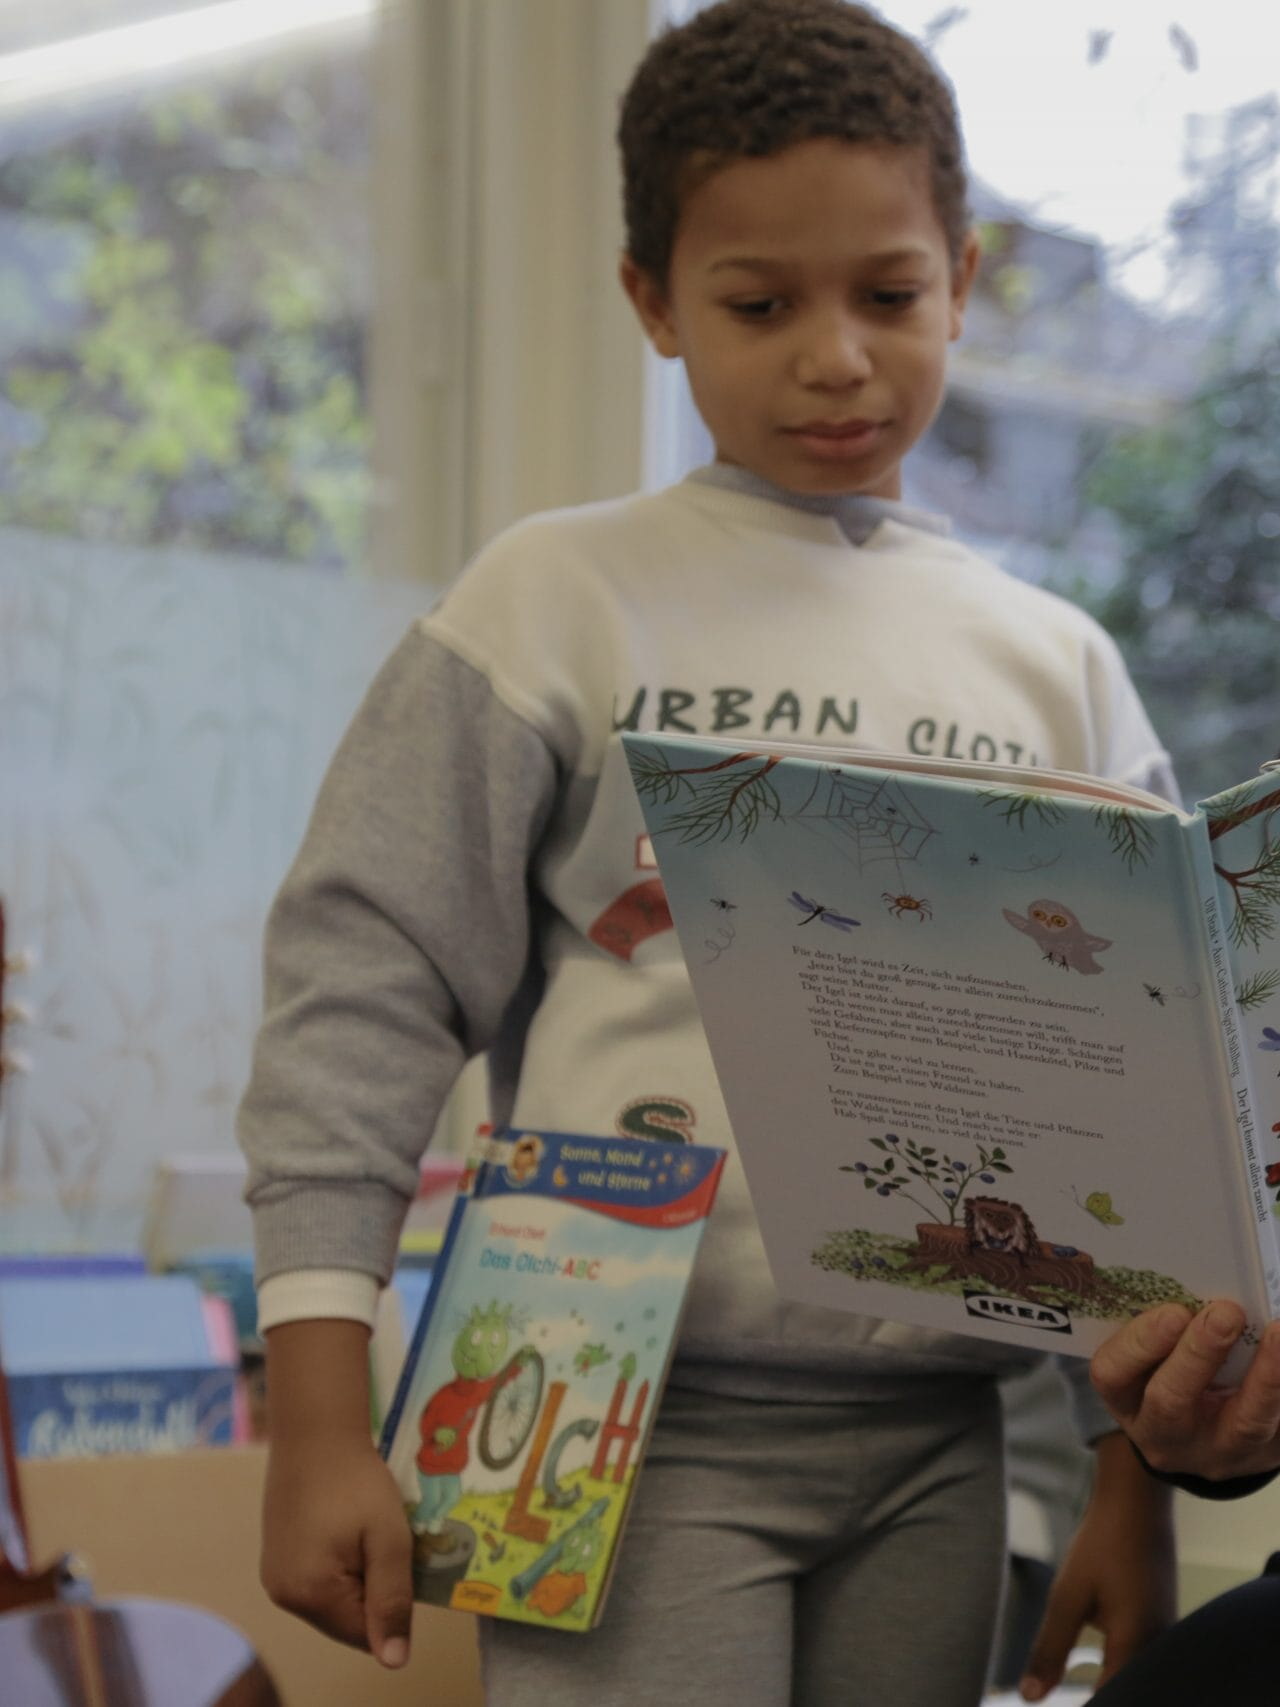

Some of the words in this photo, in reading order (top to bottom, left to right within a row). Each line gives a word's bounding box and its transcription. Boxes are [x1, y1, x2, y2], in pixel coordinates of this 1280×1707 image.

[613, 687, 860, 735] URBAN
[908, 718, 1038, 767] CLOT
[815, 948, 833, 960] den
[860, 967, 874, 978] du
[801, 981, 821, 993] Der
[825, 984, 845, 997] Igel
[932, 1004, 942, 1013] so
[1029, 1021, 1041, 1029] zu
[1236, 1087, 1249, 1107] Der
[1236, 1108, 1253, 1128] Igel
[1243, 1128, 1259, 1161] kommt
[605, 1149, 645, 1167] Mond
[578, 1170, 605, 1185] und
[1249, 1162, 1263, 1189] allein
[1253, 1188, 1269, 1223] zurecht
[480, 1248, 511, 1270] Das
[979, 1299, 1060, 1325] IKEA
